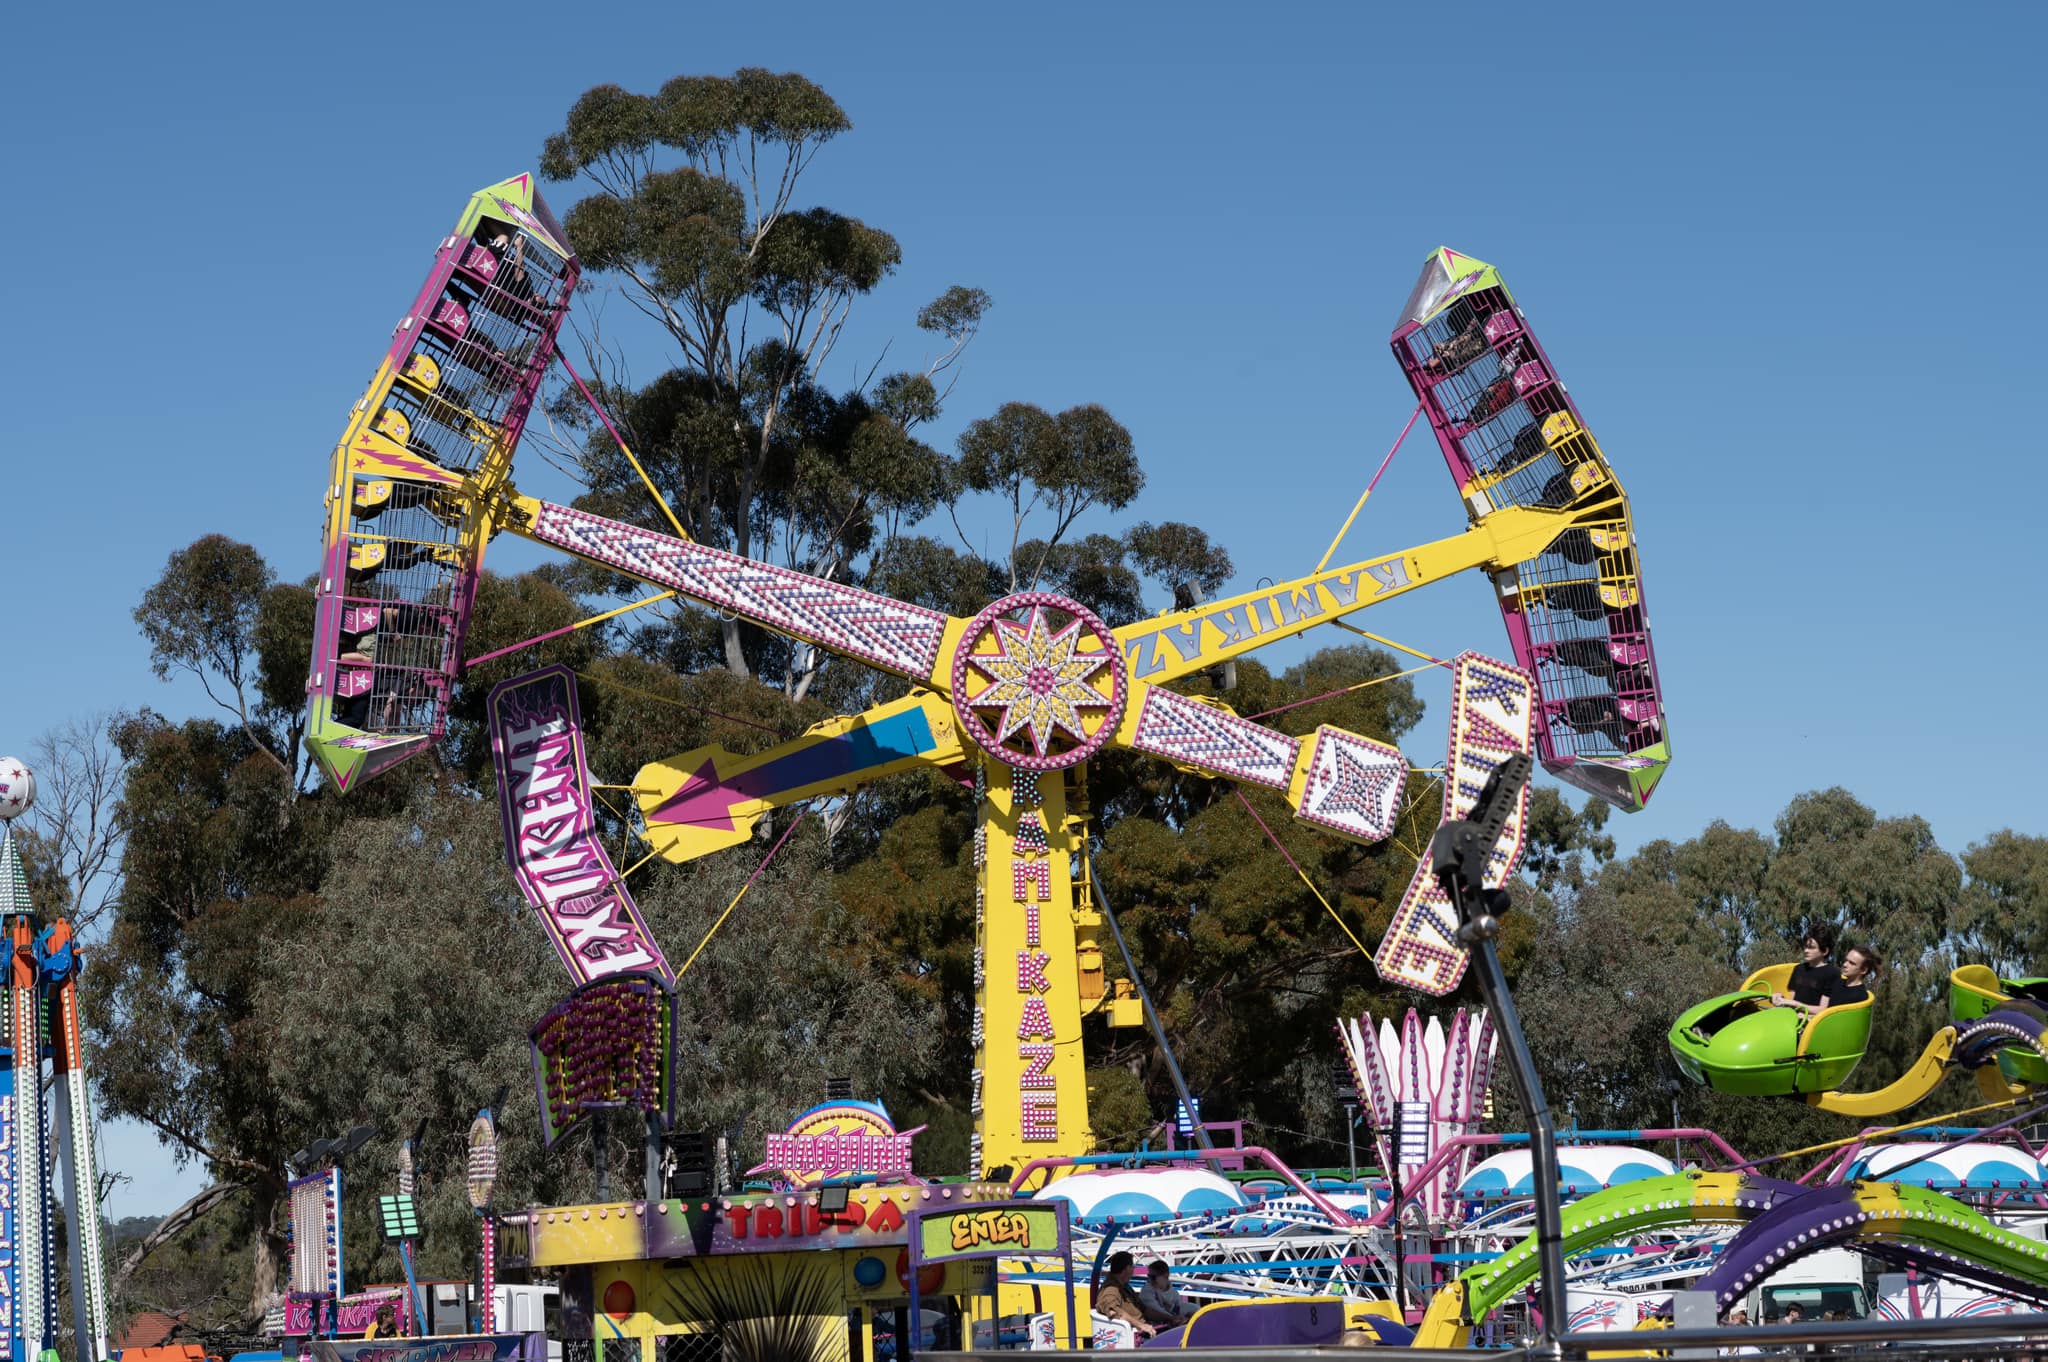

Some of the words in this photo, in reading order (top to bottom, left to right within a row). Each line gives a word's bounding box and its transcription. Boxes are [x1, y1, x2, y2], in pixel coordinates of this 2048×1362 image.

[1126, 557, 1411, 679] KAMIKAZ
[504, 708, 662, 982] EXTREME
[1011, 767, 1058, 1142] KAMIKAZE
[1982, 999, 1991, 1014] 5
[766, 1134, 913, 1171] MACHINE
[951, 1209, 1030, 1251] ENTER
[1310, 1305, 1318, 1326] 8
